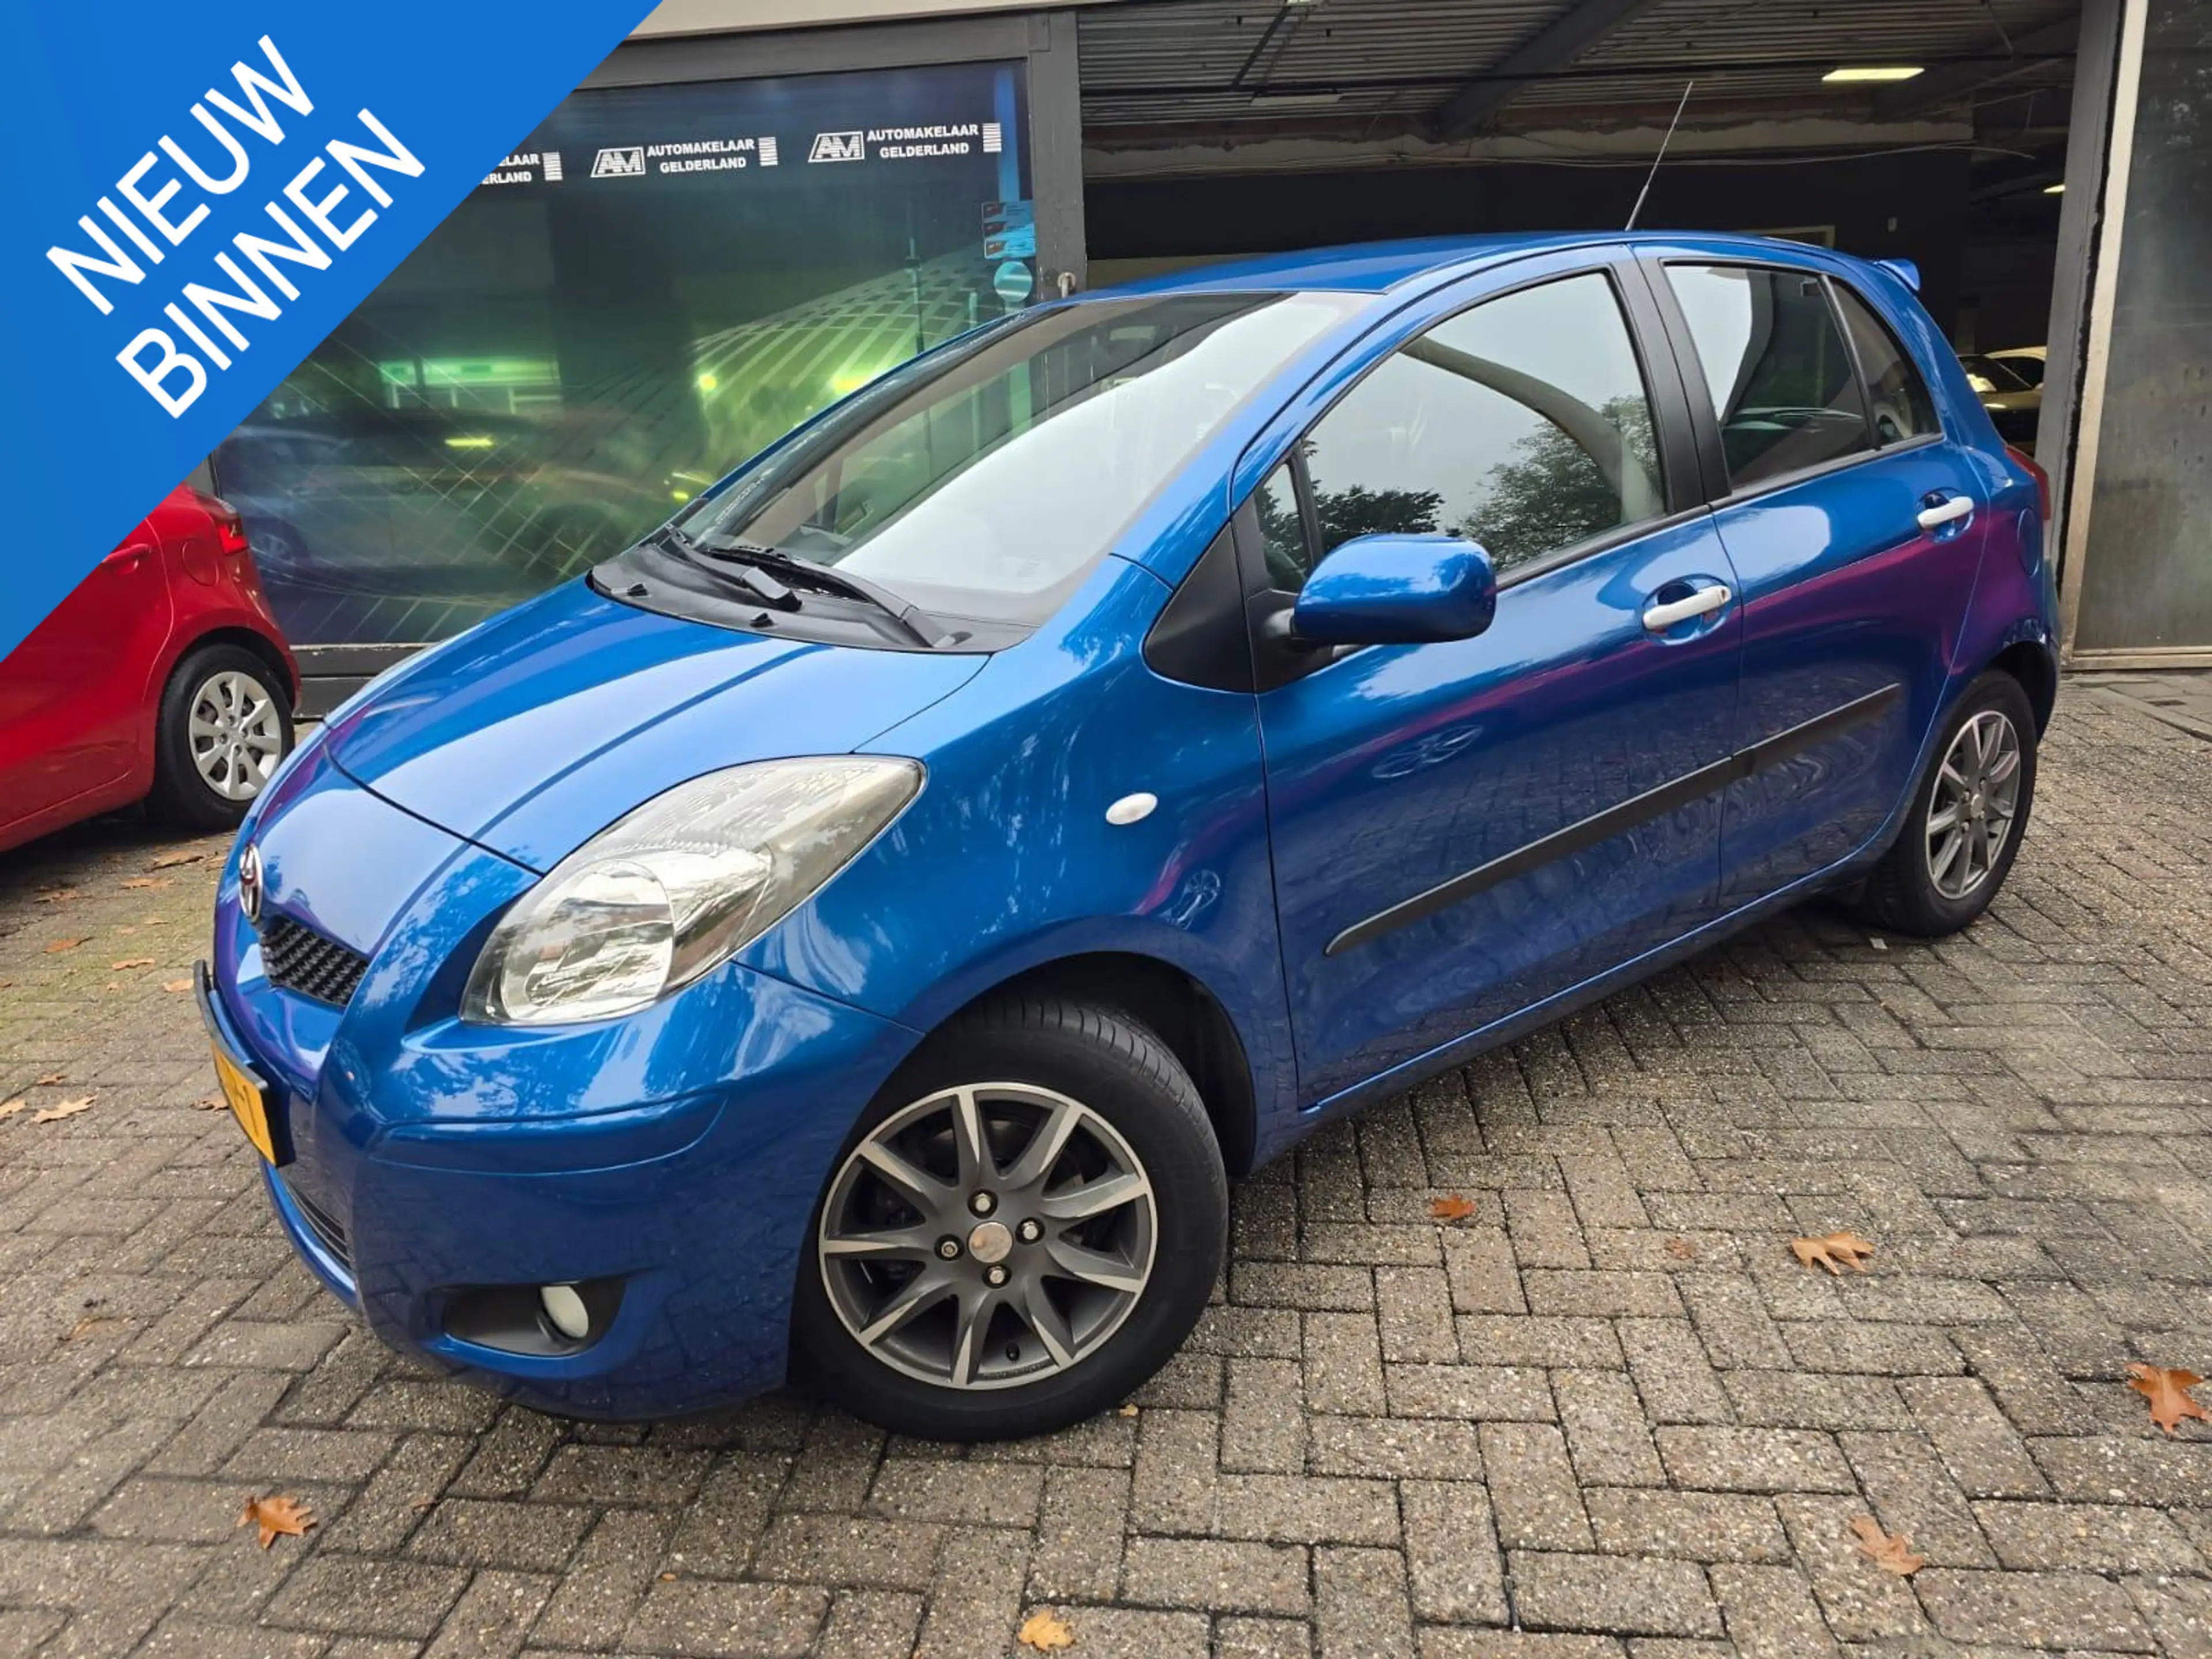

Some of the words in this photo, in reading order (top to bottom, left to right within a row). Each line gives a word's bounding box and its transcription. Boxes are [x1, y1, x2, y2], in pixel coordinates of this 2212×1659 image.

[867, 124, 979, 142] AUTOMAKELAAR
[647, 138, 755, 157] AUTOMAKELAAR
[879, 142, 969, 159] GELDERLAND
[660, 157, 747, 173] GELDERLAND
